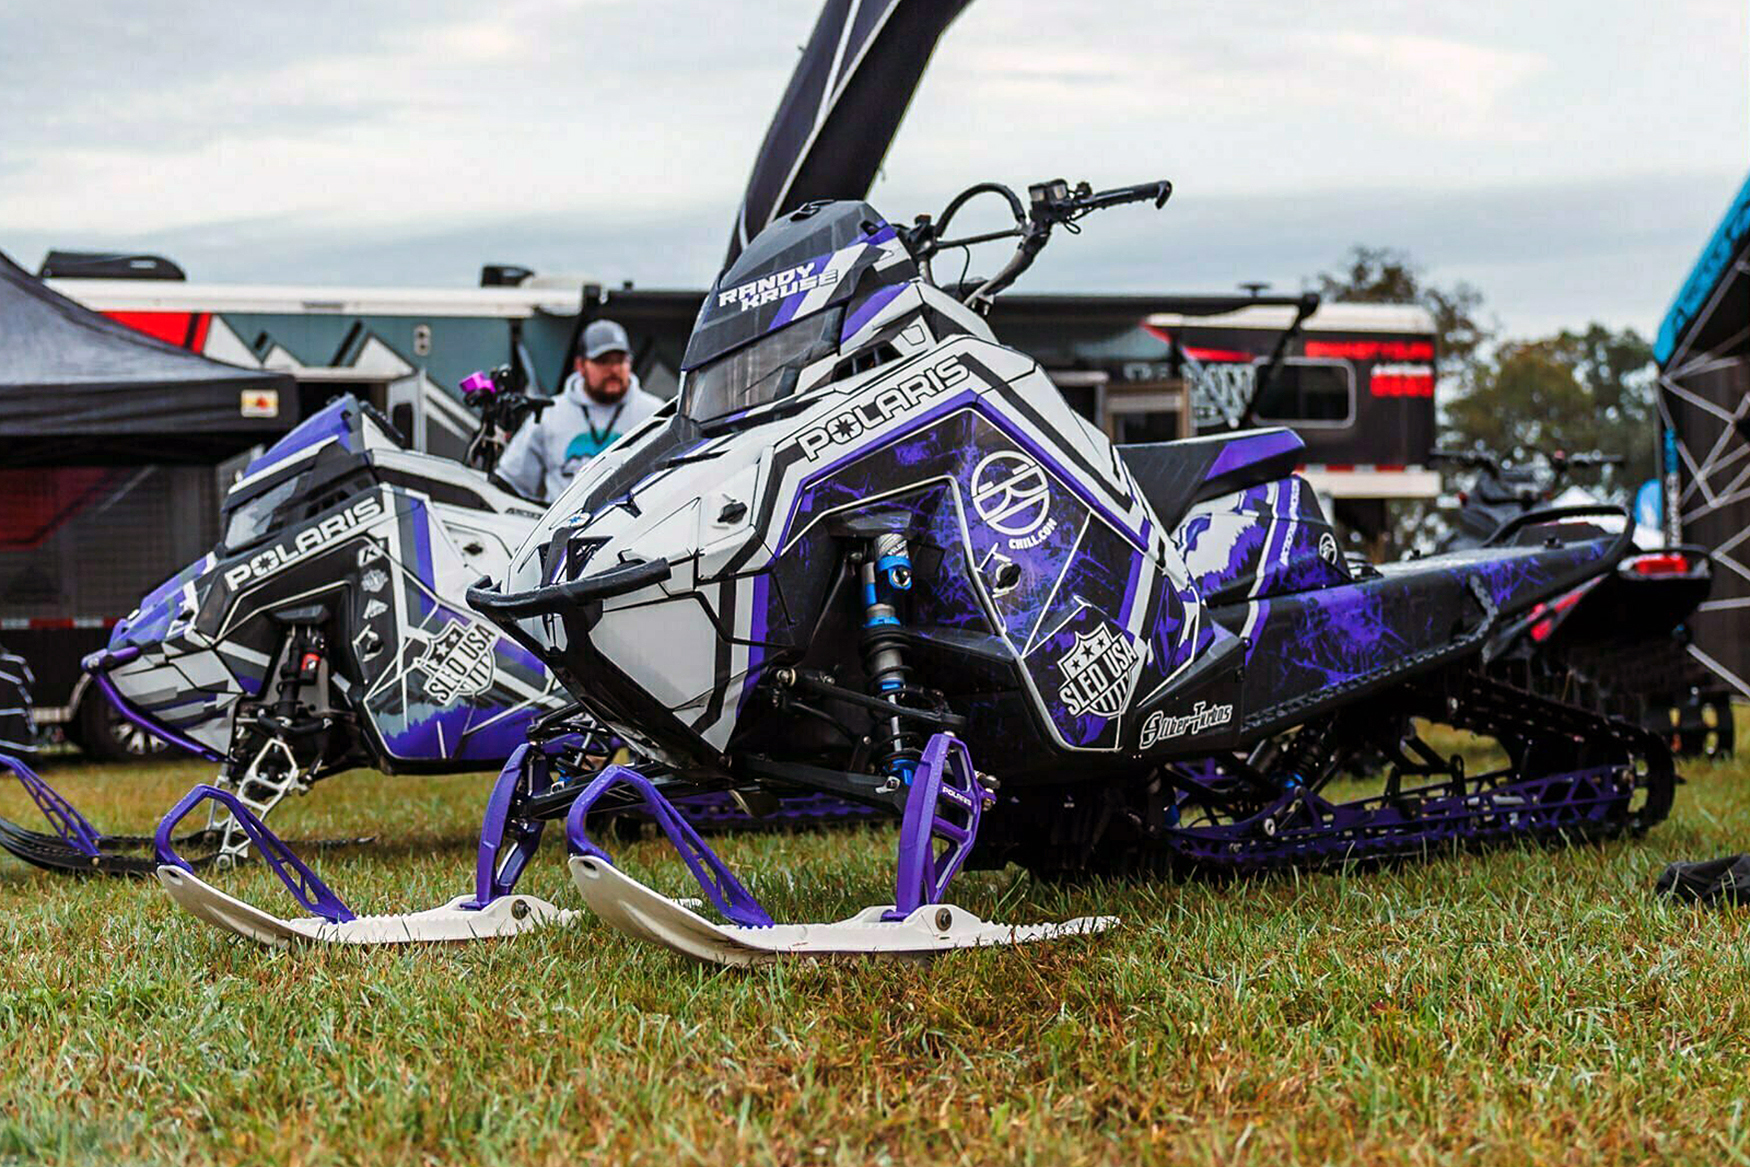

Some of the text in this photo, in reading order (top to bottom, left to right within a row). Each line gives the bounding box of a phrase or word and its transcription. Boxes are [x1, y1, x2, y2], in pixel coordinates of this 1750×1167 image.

[718, 262, 815, 308] RANDY
[740, 269, 838, 312] KRUSE
[796, 355, 970, 462] POLARIS
[224, 497, 382, 592] POLARIS
[1008, 518, 1058, 550] CHILL.COM
[428, 623, 496, 701] SLED USA
[1059, 634, 1138, 716] SLED USA
